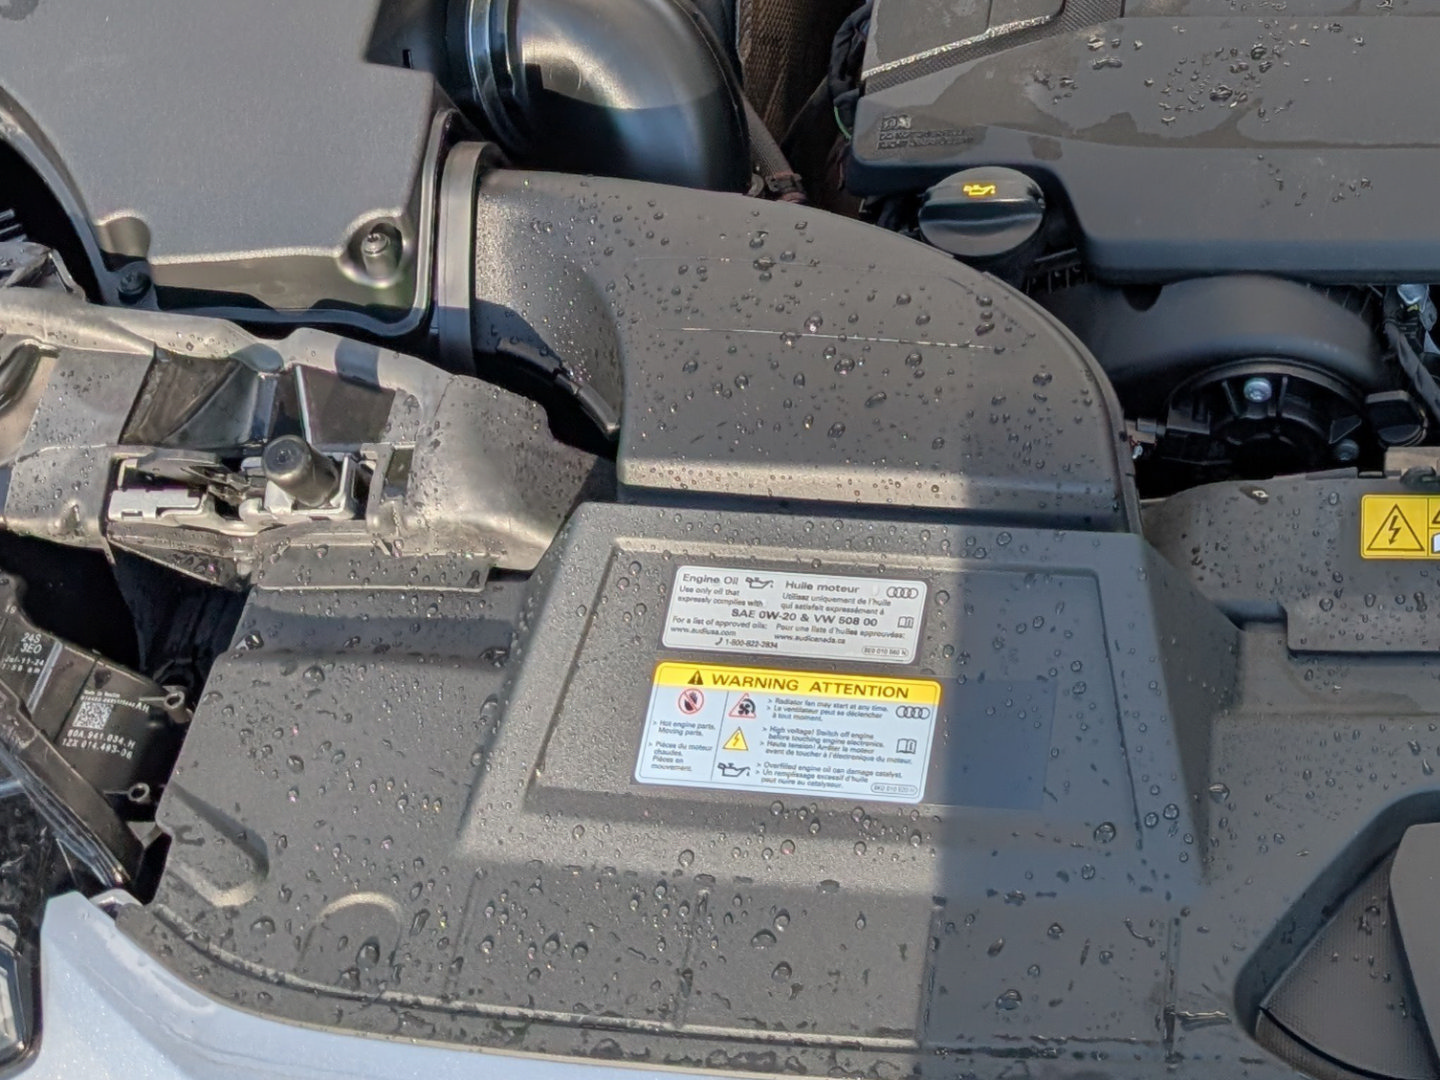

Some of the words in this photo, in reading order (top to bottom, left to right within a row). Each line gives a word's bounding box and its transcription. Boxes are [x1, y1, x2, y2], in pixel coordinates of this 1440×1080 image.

[682, 574, 720, 584] Engine
[724, 576, 739, 585] Oil
[696, 587, 711, 596] only
[785, 581, 814, 590] Huile
[817, 583, 860, 593] moteur
[678, 596, 711, 604] expressly
[713, 598, 746, 606] complies
[782, 592, 809, 601] Utilisez
[811, 594, 855, 604] uniquement
[868, 598, 891, 606] l'huile
[780, 602, 792, 610] qui
[826, 605, 878, 614] expressément
[672, 616, 684, 624] For
[693, 617, 704, 625] list
[715, 620, 751, 629] approved
[752, 622, 767, 630] oils:
[731, 608, 755, 617] SAE
[759, 611, 796, 621] 0W-20
[800, 613, 809, 622] &
[814, 614, 836, 623] VW
[838, 616, 860, 626] 508
[864, 618, 878, 626] 00
[670, 627, 736, 636] www.audiusa.com
[811, 626, 826, 634] liste
[828, 627, 858, 636] d'huiles
[21, 632, 41, 643] 24S
[774, 634, 846, 644] www.audicanada.ca
[712, 673, 799, 692] WARNING
[809, 680, 909, 699] ATTENTION
[135, 701, 150, 713] AH
[775, 698, 803, 706] Radiator
[858, 704, 870, 712] any
[872, 704, 889, 712] time.
[784, 706, 819, 714] ventilateur
[820, 708, 835, 716] peut
[846, 710, 883, 719] déclencher
[658, 727, 684, 736] Moving
[770, 726, 785, 735] High
[787, 727, 815, 736] voltage!
[816, 728, 839, 737] Switch
[840, 730, 850, 738] off
[851, 732, 874, 740] engine
[655, 741, 676, 749] Pièces
[767, 740, 786, 748] Haute
[788, 742, 816, 750] tension!
[768, 733, 789, 741] before
[792, 735, 821, 744] touching
[823, 737, 845, 745] engine
[847, 739, 885, 748] electronics.
[653, 755, 673, 763] Pièces
[796, 750, 821, 758] toucher
[886, 757, 912, 765] moteur.
[764, 761, 797, 770] Overfilled
[798, 764, 821, 772] engine
[847, 768, 873, 777] damage
[875, 770, 903, 779] catalyst.
[761, 777, 776, 785] peut
[807, 780, 843, 789] catalyseur.
[774, 771, 815, 780] remplissage
[817, 773, 843, 781] excessif
[845, 775, 869, 783] d'huile
